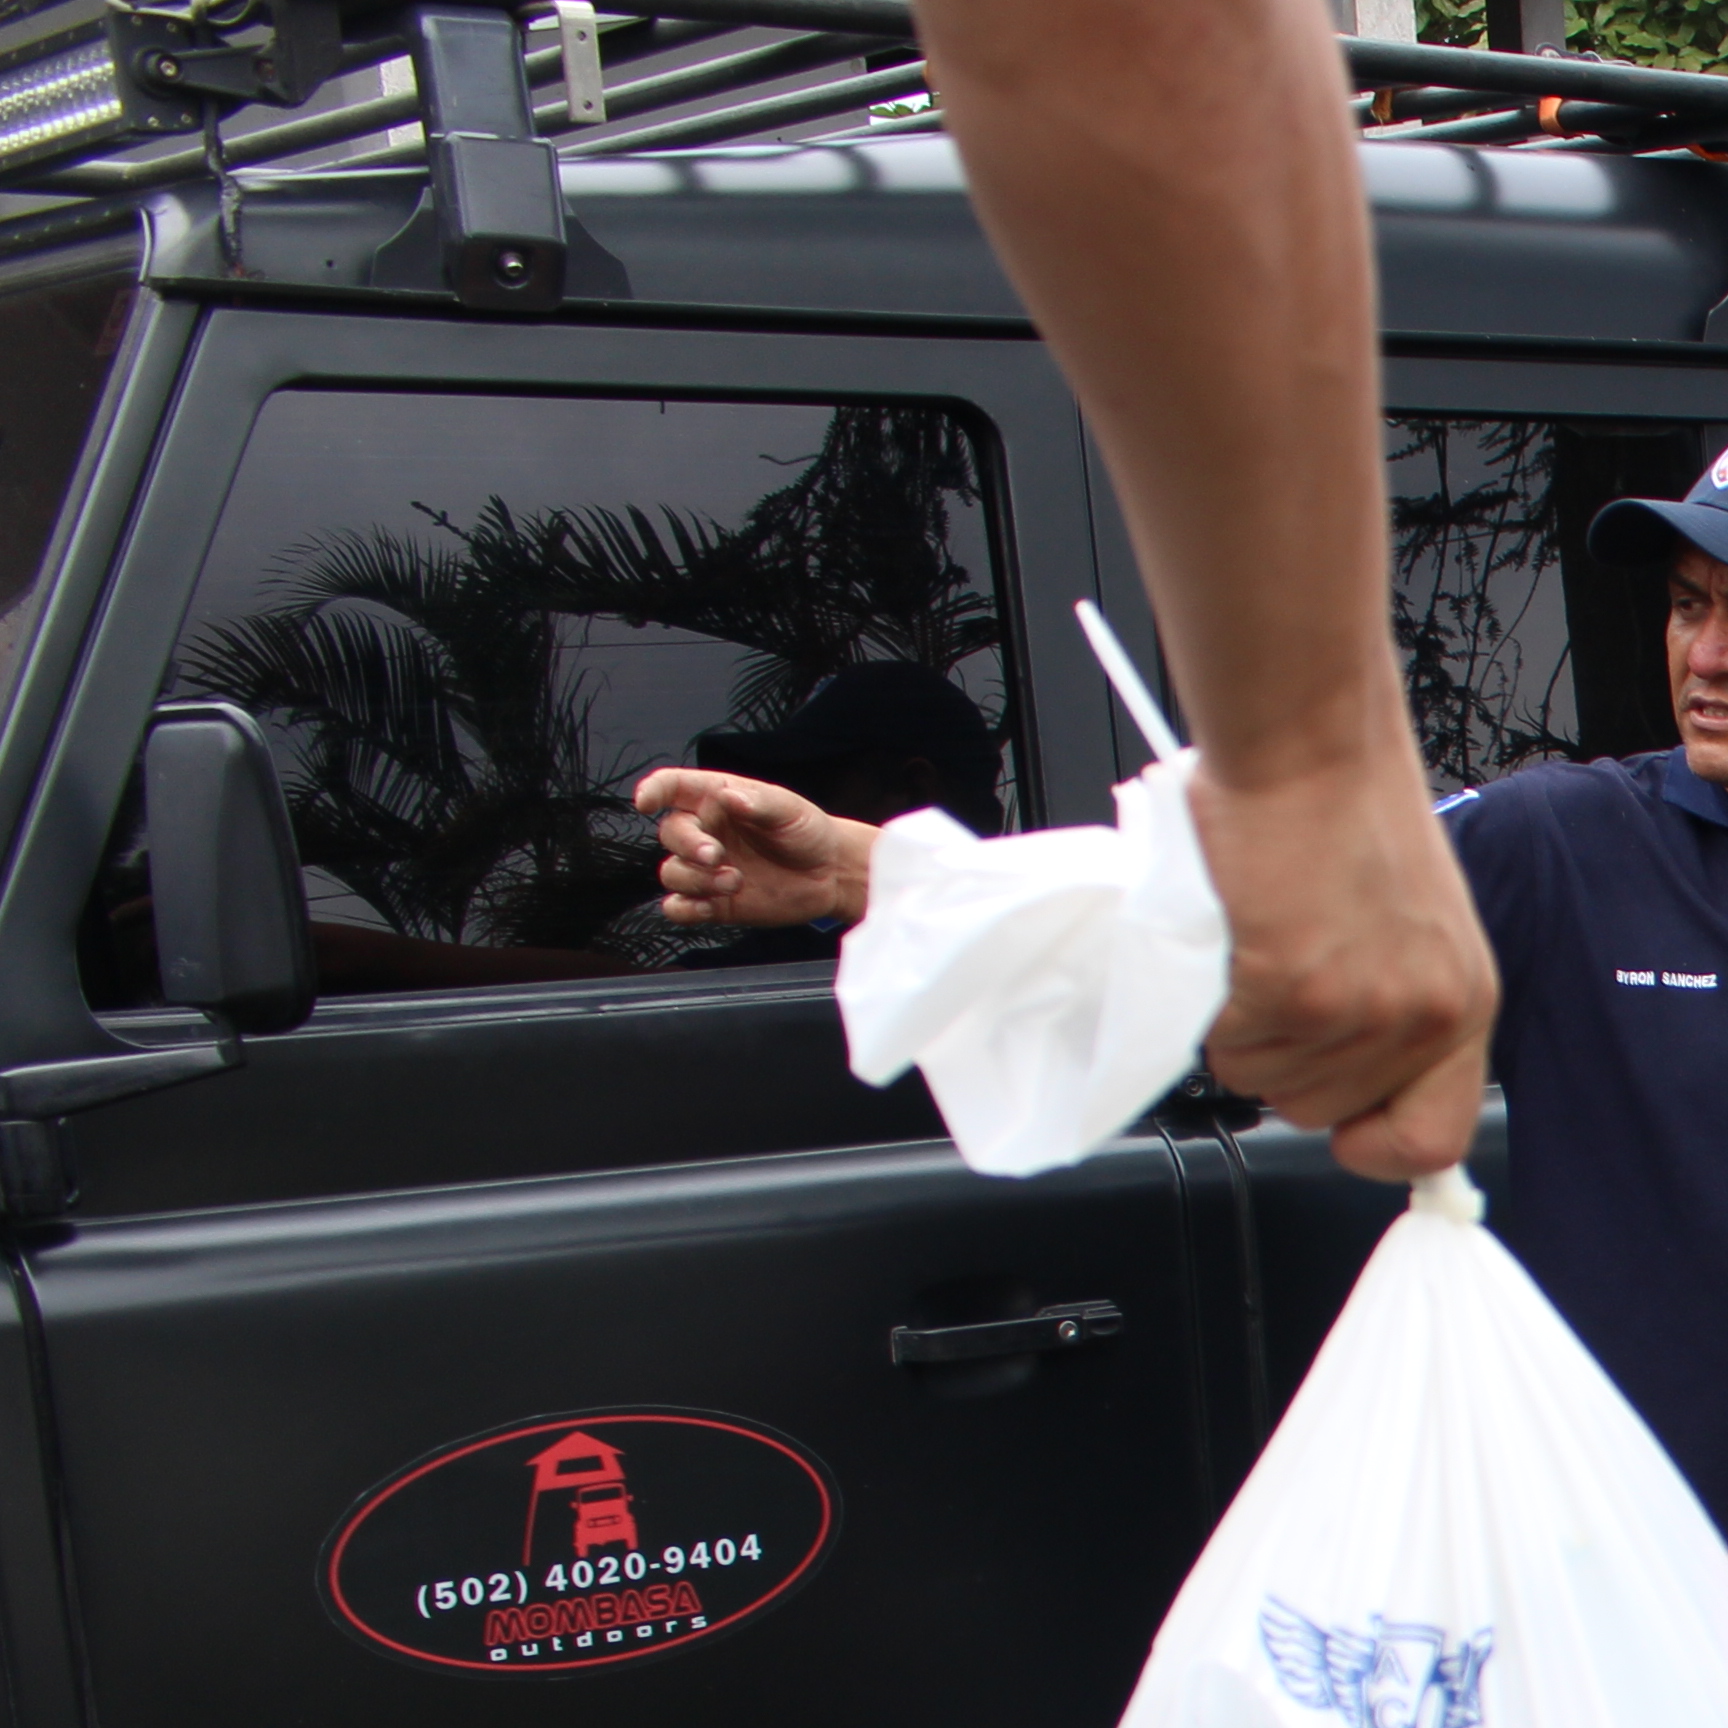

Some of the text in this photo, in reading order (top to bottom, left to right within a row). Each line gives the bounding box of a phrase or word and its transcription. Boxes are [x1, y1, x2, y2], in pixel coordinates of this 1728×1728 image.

[1615, 969, 1718, 989] BYRON SANCHEZ
[416, 1533, 763, 1619] (502) 4020-9404
[483, 1581, 703, 1647] MOMBASA
[489, 1613, 709, 1662] outdoors
